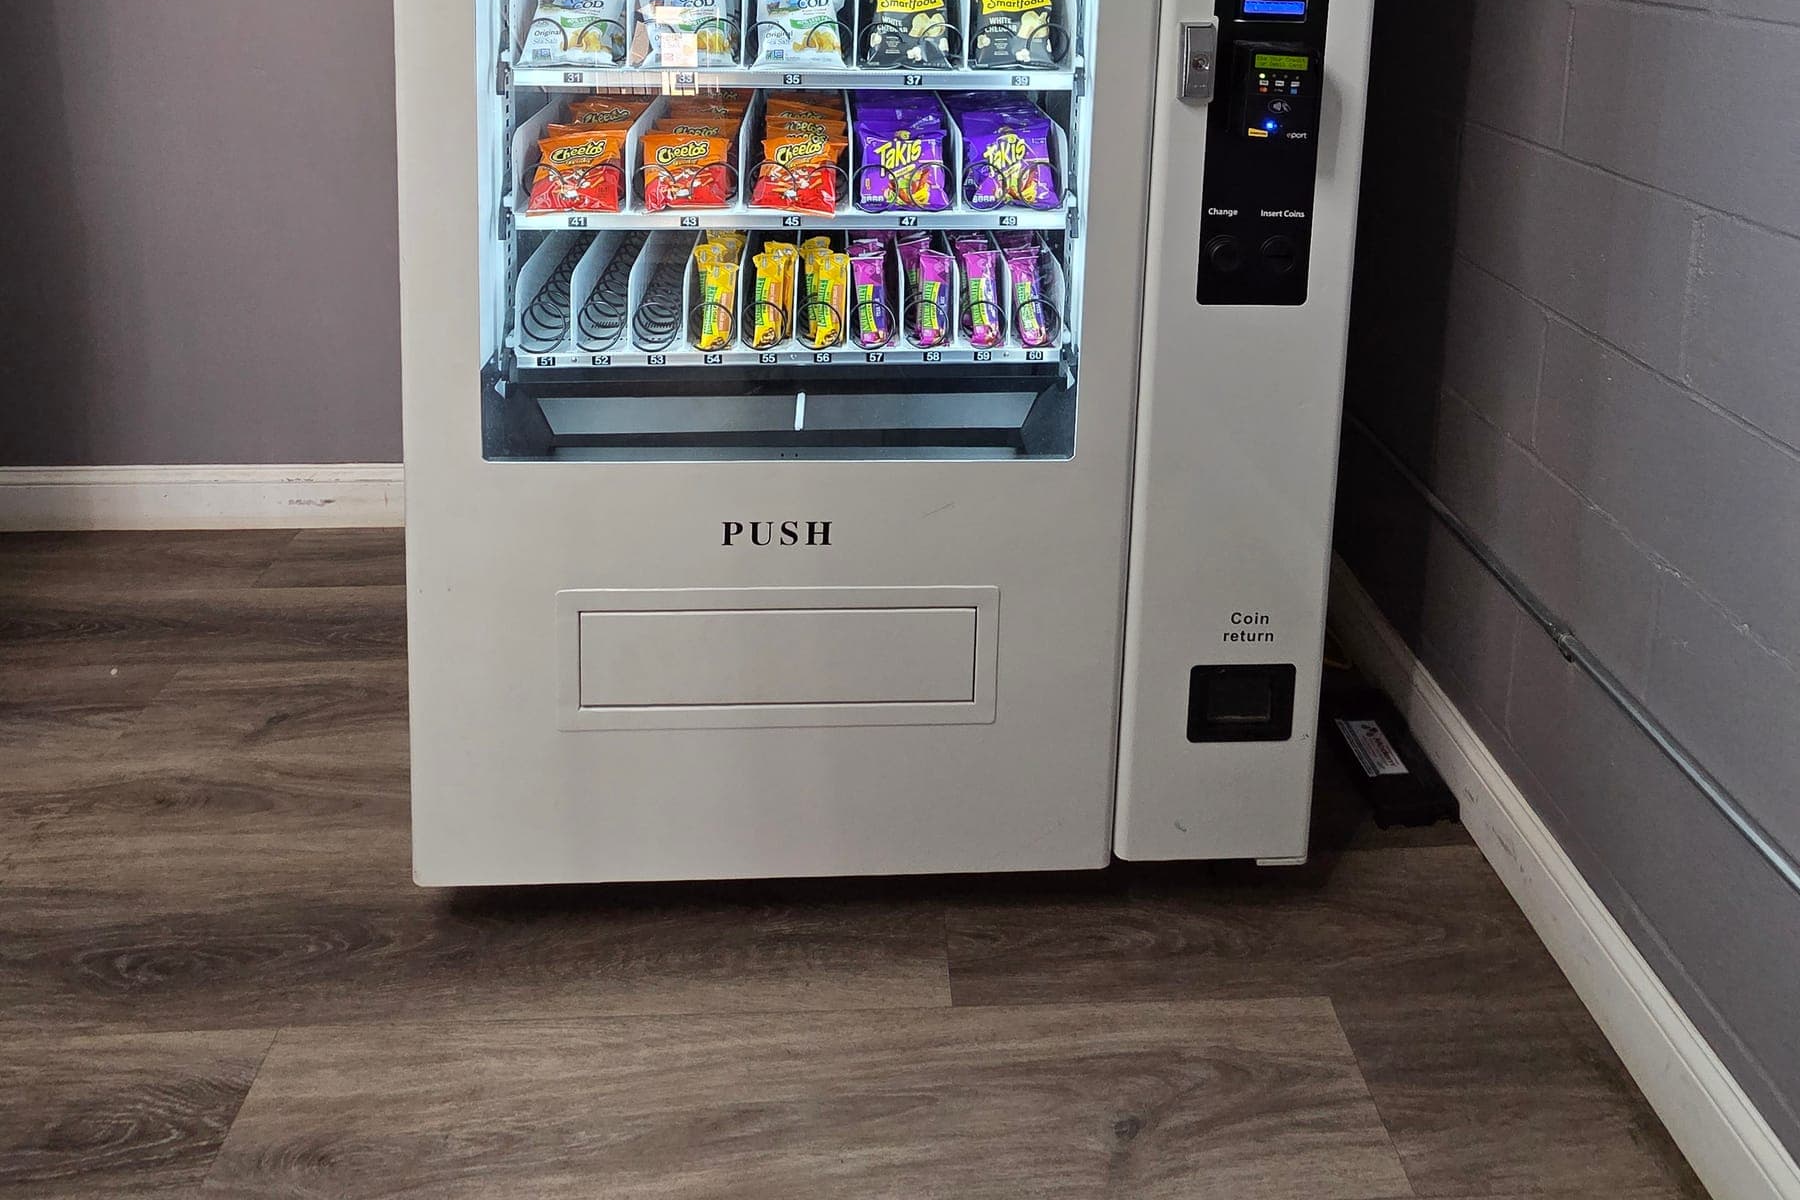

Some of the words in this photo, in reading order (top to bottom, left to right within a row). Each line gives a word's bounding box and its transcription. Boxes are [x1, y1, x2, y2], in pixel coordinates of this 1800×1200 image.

[881, 15, 903, 27] WHITE
[988, 16, 1012, 25] WHITE
[567, 73, 581, 83] 31
[785, 74, 800, 84] 35
[907, 76, 921, 85] 37
[1014, 76, 1028, 86] 39
[551, 141, 606, 162] Cheetos
[658, 141, 709, 164] Cheetos
[776, 140, 821, 165] Cheetos
[1208, 207, 1239, 217] Change
[1260, 209, 1283, 218] Insert
[1284, 209, 1305, 218] Coins
[571, 217, 585, 226] 41
[683, 217, 697, 226] 43
[784, 216, 799, 226] 45
[901, 216, 916, 226] 47
[1002, 216, 1017, 226] 49
[595, 356, 608, 365] 52
[650, 355, 664, 364] 53
[706, 354, 720, 364] 54
[762, 353, 776, 362] 55
[816, 353, 830, 362] 56
[869, 352, 883, 362] 57
[926, 352, 939, 361] 58
[976, 352, 990, 361] 59
[1029, 351, 1042, 360] 60
[540, 356, 554, 366] 51
[721, 520, 833, 546] PUSH
[1230, 611, 1270, 626] Coin
[1223, 629, 1275, 643] return
